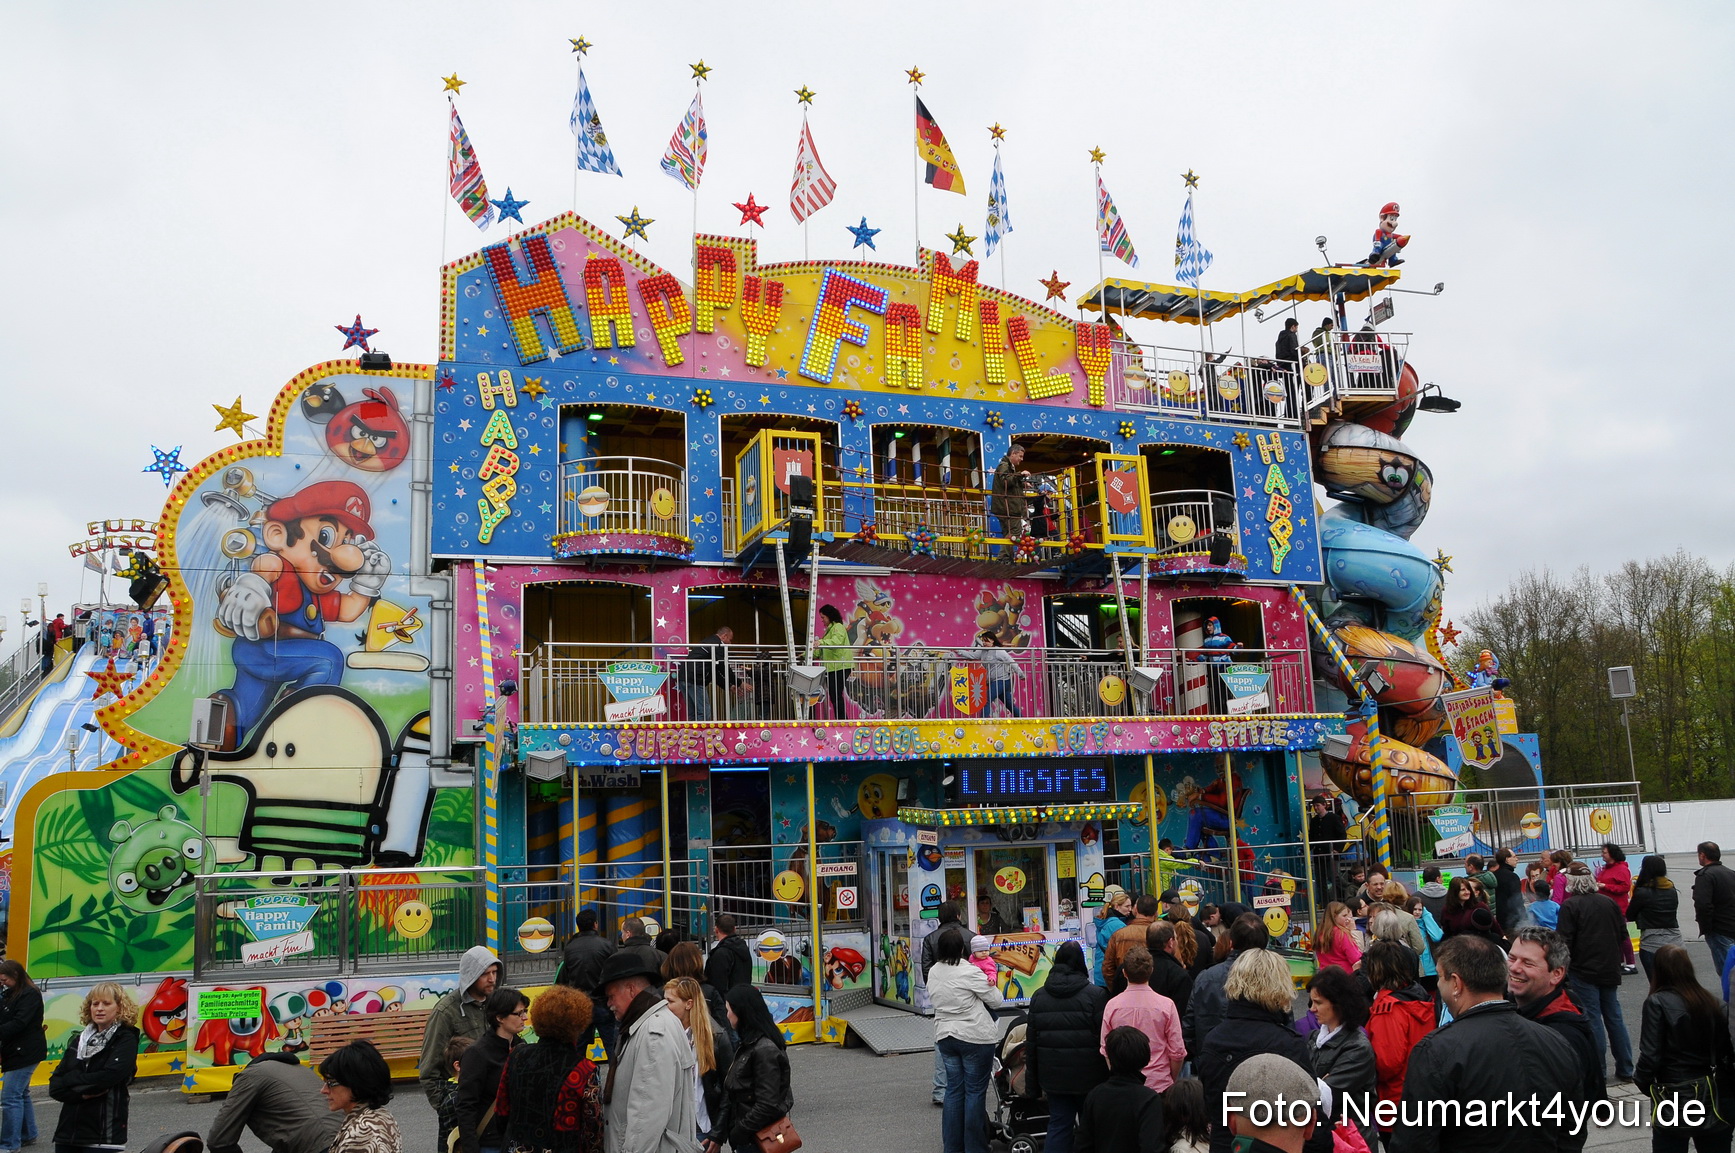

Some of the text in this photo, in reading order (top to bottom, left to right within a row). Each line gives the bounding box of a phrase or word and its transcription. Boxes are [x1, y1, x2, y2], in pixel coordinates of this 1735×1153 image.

[482, 233, 1111, 406] HAPPY FAMILY
[477, 370, 521, 543] HAPPY
[1255, 432, 1293, 574] HAPPY
[614, 662, 653, 671] SUPER
[606, 676, 644, 685] Happy
[1227, 676, 1254, 685] Happy
[615, 686, 656, 696] Family
[1234, 685, 1263, 693] Family
[1447, 701, 1460, 712] DER
[1459, 697, 1473, 713] IRRE
[1474, 695, 1493, 708] SPASS
[609, 706, 636, 720] macht
[1208, 719, 1290, 747] SPITZE
[1454, 717, 1466, 741] 4
[852, 726, 930, 754] COOL
[1050, 721, 1110, 751] TOP
[613, 728, 728, 759] SUPER
[603, 764, 625, 774] Mr.
[590, 773, 639, 787] Wash
[1435, 818, 1458, 826] Happy
[1441, 825, 1467, 834] Family
[821, 865, 854, 873] EINGANG
[255, 895, 300, 906] SUPER
[1256, 897, 1285, 905] AUSGANG
[245, 911, 290, 922] Happy
[255, 920, 305, 931] Family
[247, 945, 279, 962] macht
[1001, 938, 1035, 960] KASSE
